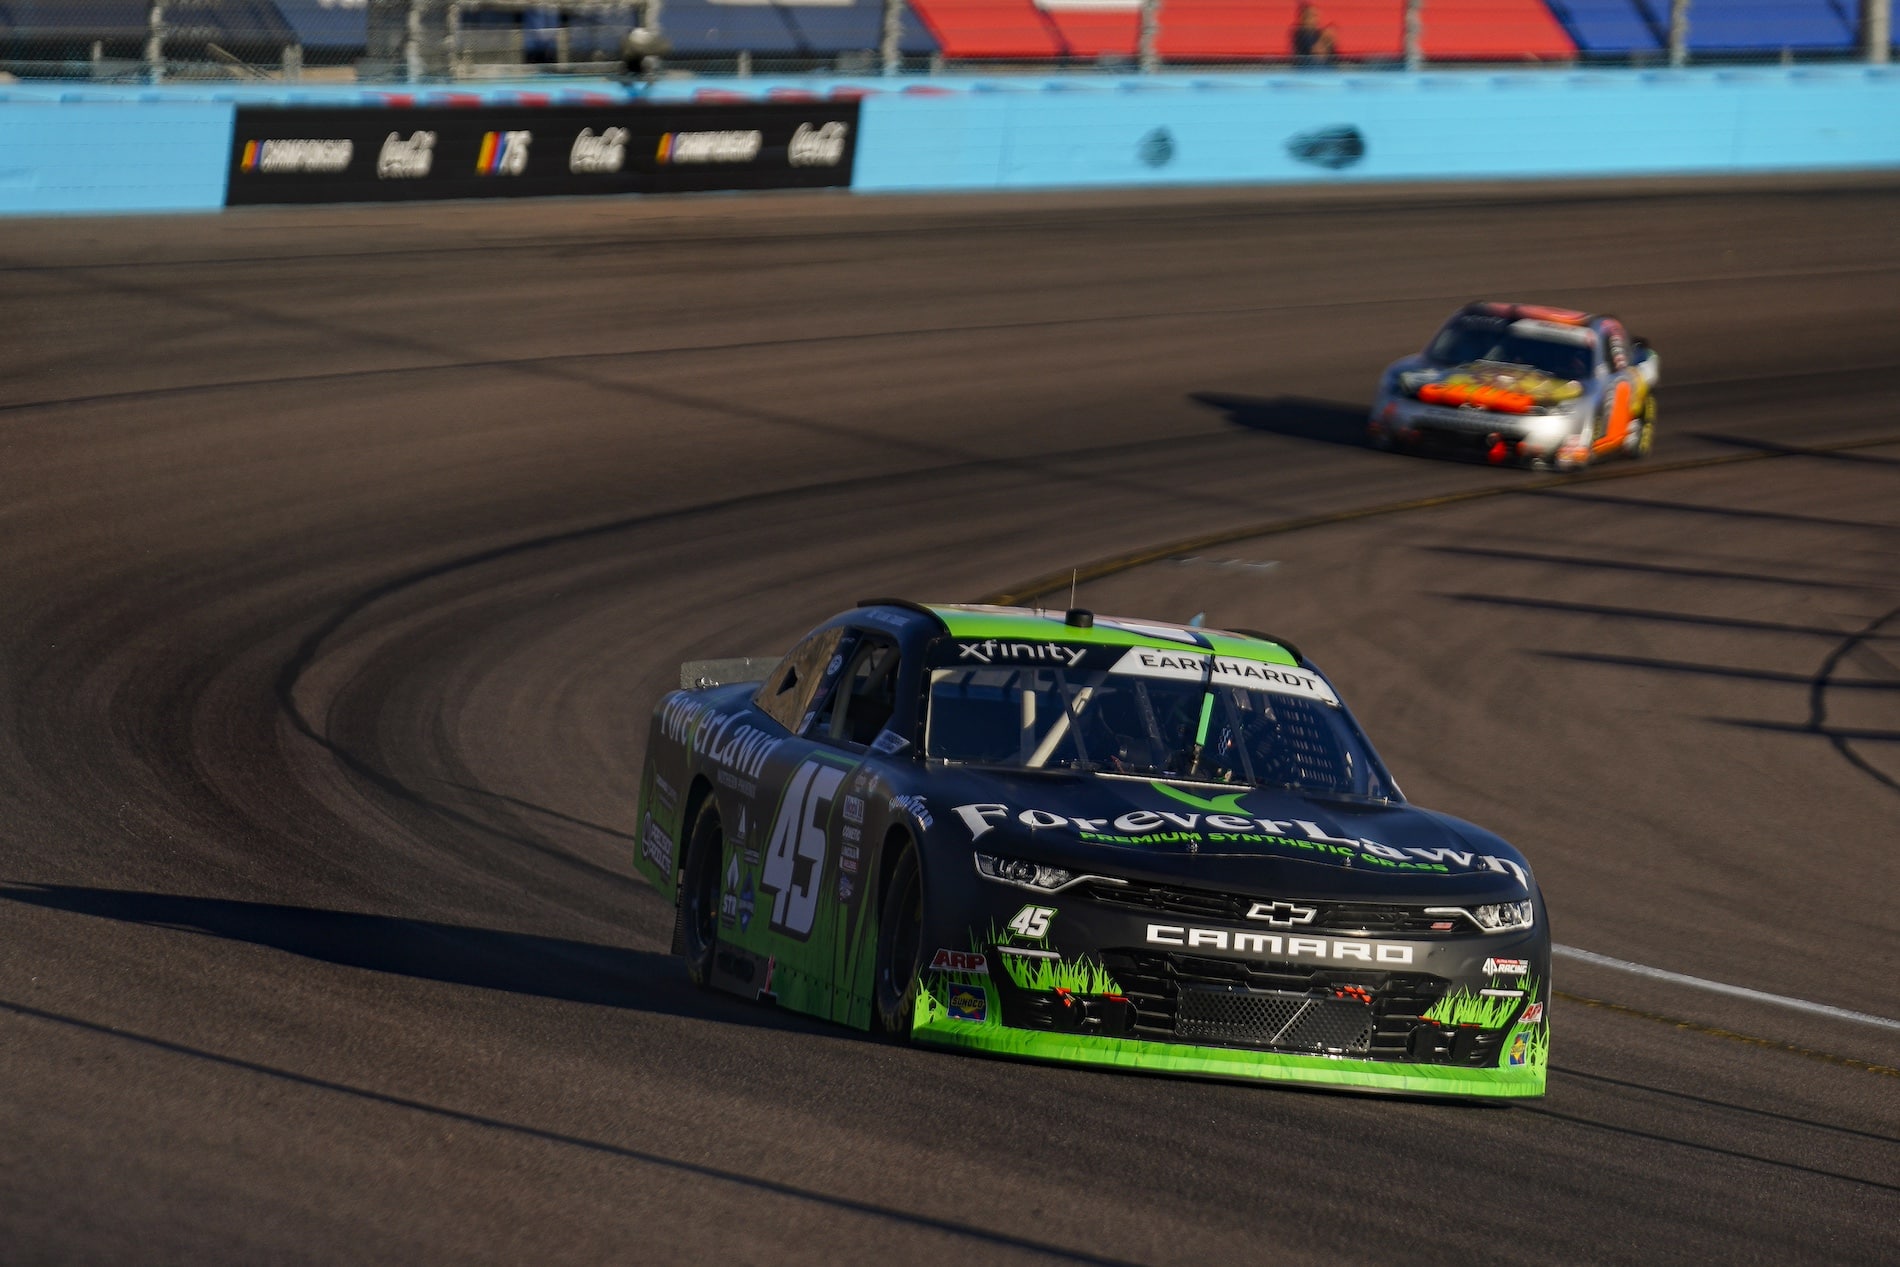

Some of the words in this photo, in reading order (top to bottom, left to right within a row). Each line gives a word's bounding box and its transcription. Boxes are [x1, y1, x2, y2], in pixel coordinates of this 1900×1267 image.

[958, 639, 1087, 666] xfinity
[1140, 653, 1317, 691] EARNHARDT
[762, 760, 847, 935] 45
[952, 803, 1528, 891] ForeverLawn
[1080, 831, 1203, 844] PREMIUM
[1208, 832, 1356, 857] SYNTHETIC
[1361, 853, 1449, 873] GRASS
[1008, 905, 1055, 938] 45
[933, 949, 985, 970] ARP
[1146, 923, 1414, 964] CAMARO
[1498, 963, 1528, 975] RACING
[951, 996, 985, 1009] SUNOCO
